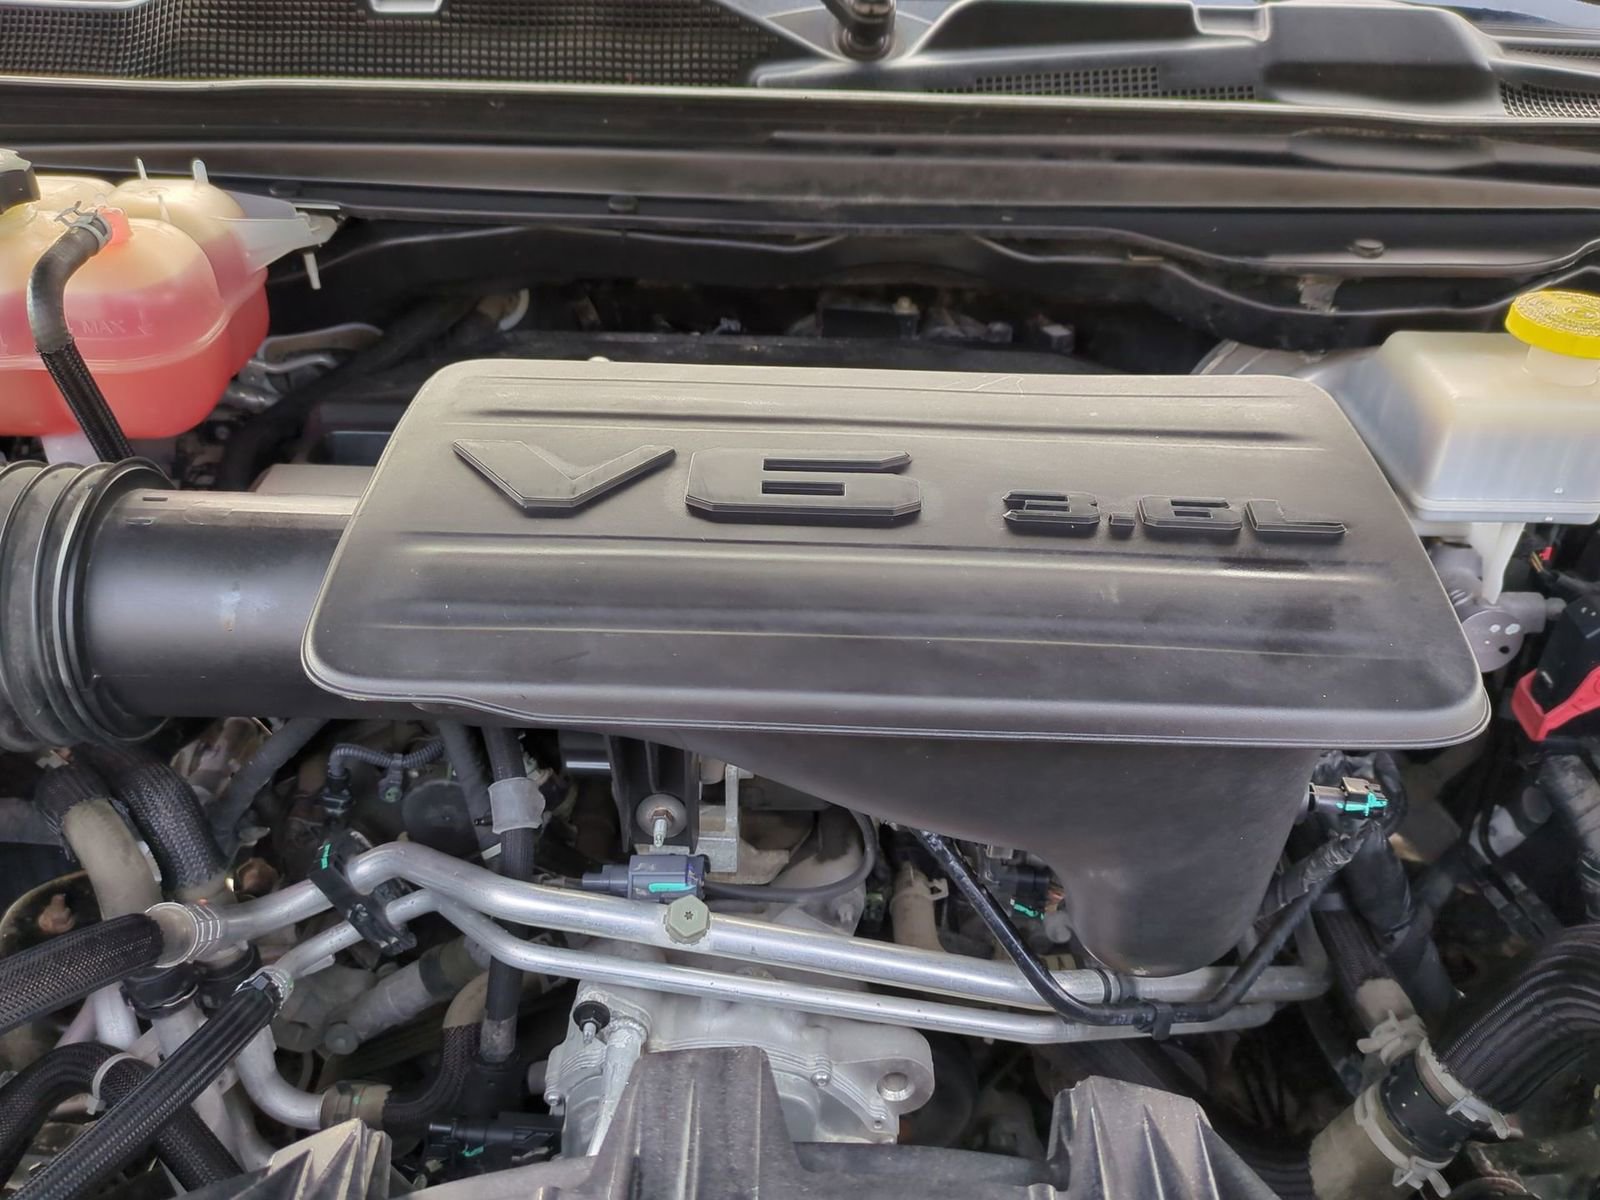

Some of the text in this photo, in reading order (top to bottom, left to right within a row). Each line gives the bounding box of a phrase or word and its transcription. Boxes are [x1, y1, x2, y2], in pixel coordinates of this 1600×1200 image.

[82, 319, 126, 334] MAX
[453, 439, 1348, 535] V6 3.6L
